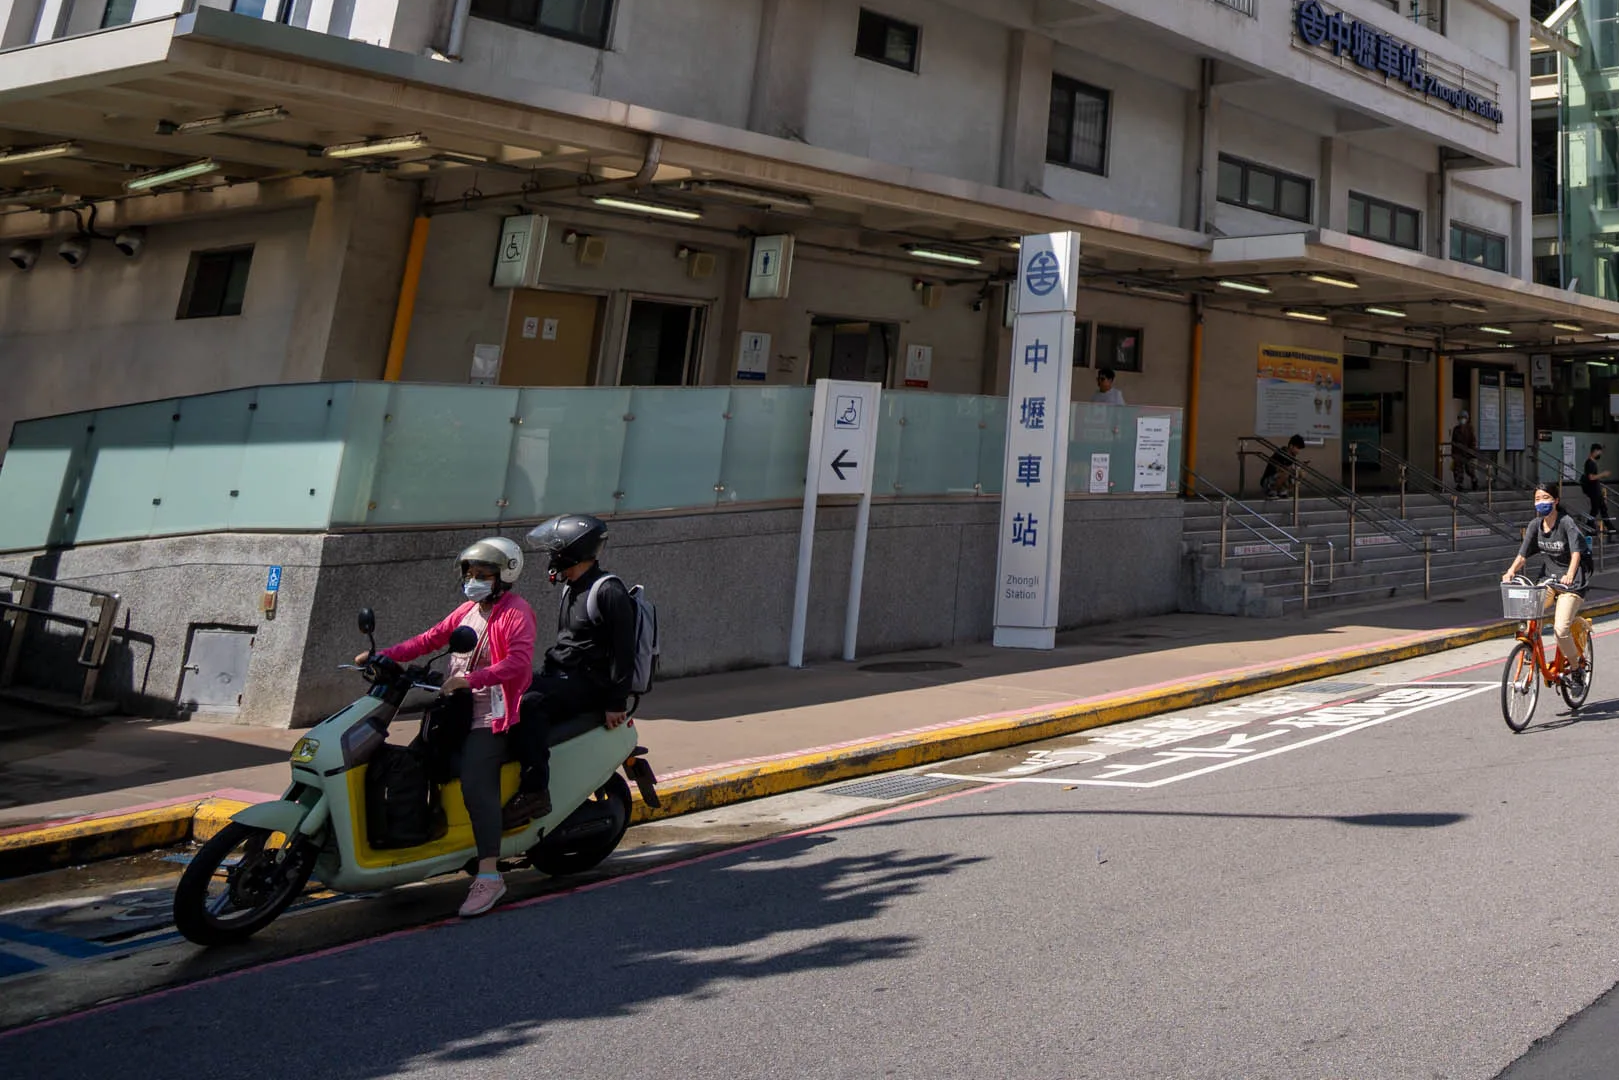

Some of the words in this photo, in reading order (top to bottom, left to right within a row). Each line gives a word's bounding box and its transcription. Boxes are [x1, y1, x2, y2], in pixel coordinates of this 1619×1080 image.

[1328, 12, 1426, 92] 中壢車站
[1426, 76, 1467, 110] Zhongli
[1468, 94, 1503, 124] Station
[1011, 338, 1049, 548] 中壢車站
[1005, 589, 1038, 601] Station
[1006, 574, 1040, 589] Zhongli
